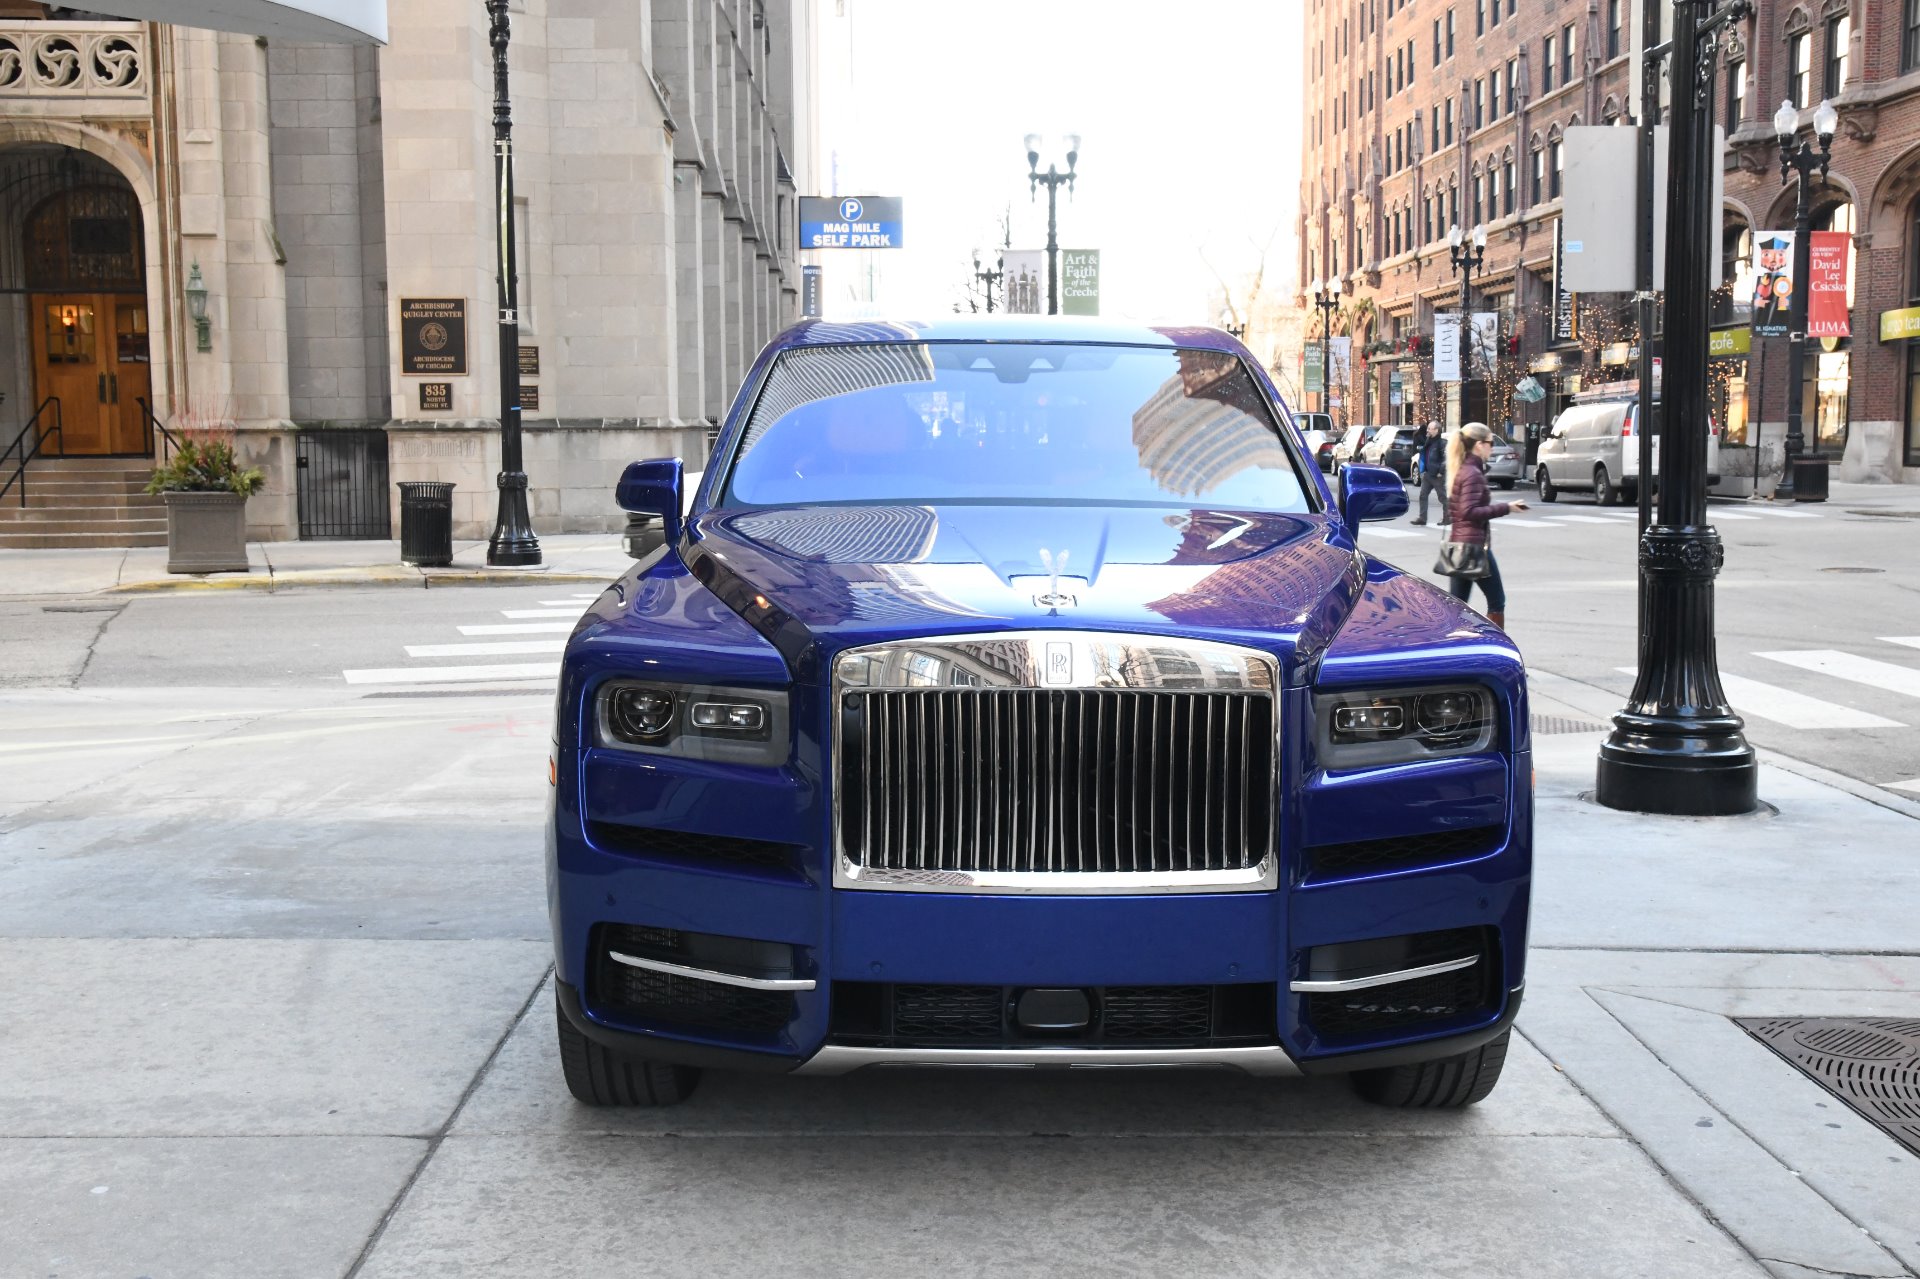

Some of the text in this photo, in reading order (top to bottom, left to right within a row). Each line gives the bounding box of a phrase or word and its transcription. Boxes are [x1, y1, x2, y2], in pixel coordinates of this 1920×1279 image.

[823, 223, 880, 233] MAG MILE
[813, 234, 890, 246] SELF PARK
[1065, 253, 1097, 264] Art &
[1812, 258, 1841, 270] David
[1065, 265, 1096, 278] Faith
[1824, 270, 1840, 280] Lee
[1071, 279, 1079, 288] of
[1811, 280, 1847, 292] Csicsko
[1064, 287, 1098, 297] Creche
[410, 302, 455, 310] ARCHBISHOP
[403, 311, 433, 319] QUIGLEY
[1559, 292, 1572, 338] EINSTEIN
[1808, 321, 1848, 333] LUMA
[425, 385, 446, 396] 835
